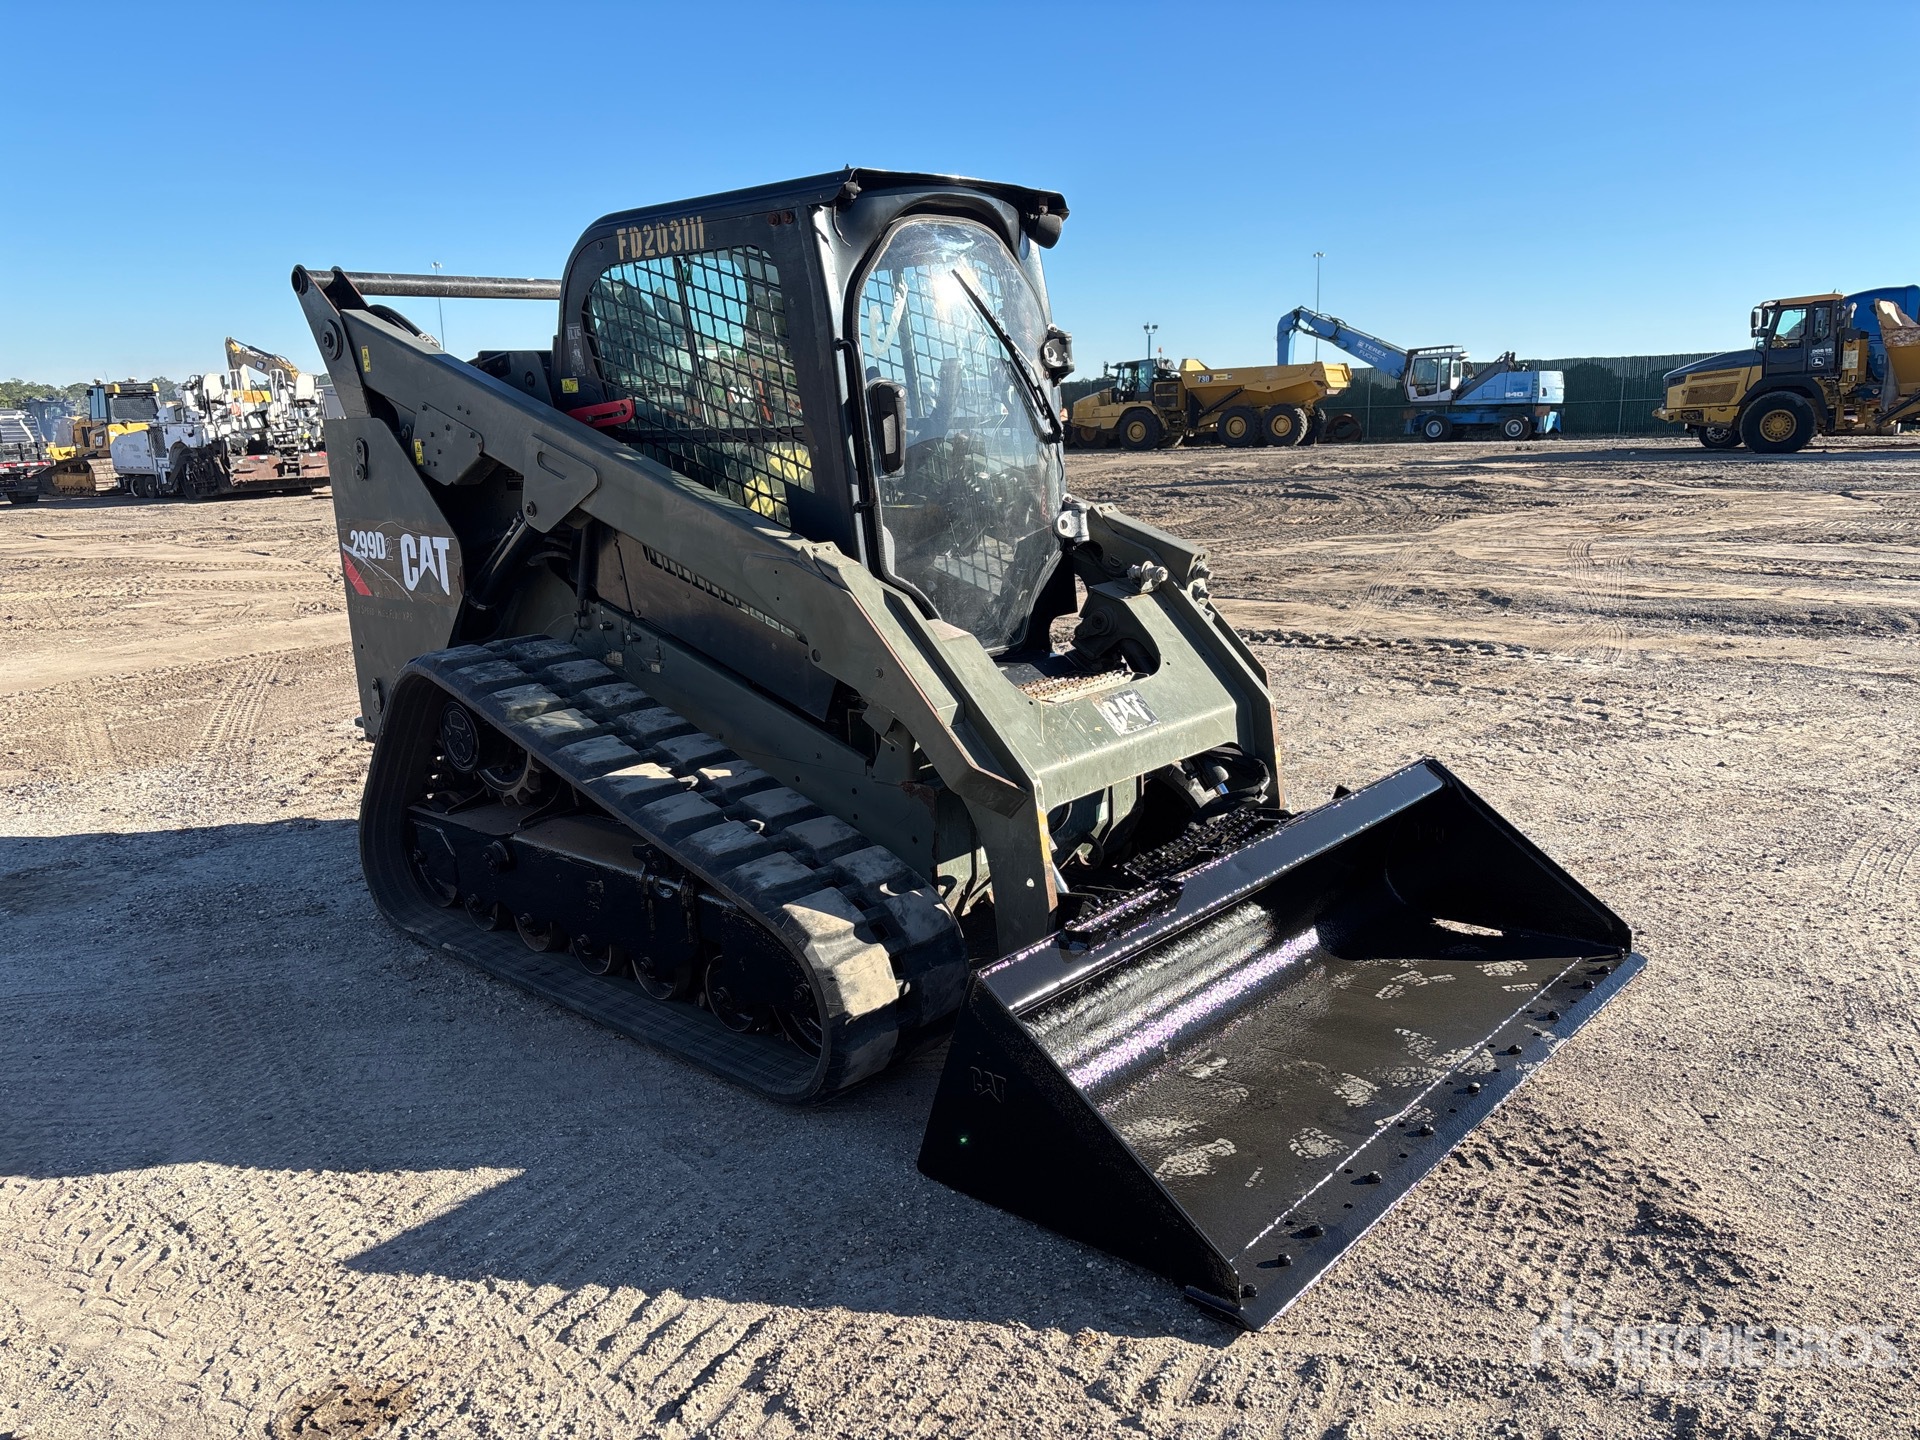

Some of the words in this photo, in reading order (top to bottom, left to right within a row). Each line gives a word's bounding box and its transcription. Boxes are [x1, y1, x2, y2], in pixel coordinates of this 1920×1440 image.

[1365, 343, 1387, 358] TEREX
[1197, 375, 1210, 383] 730
[400, 533, 450, 596] CAT
[1101, 693, 1153, 735] CAT
[969, 1066, 1008, 1104] CAT
